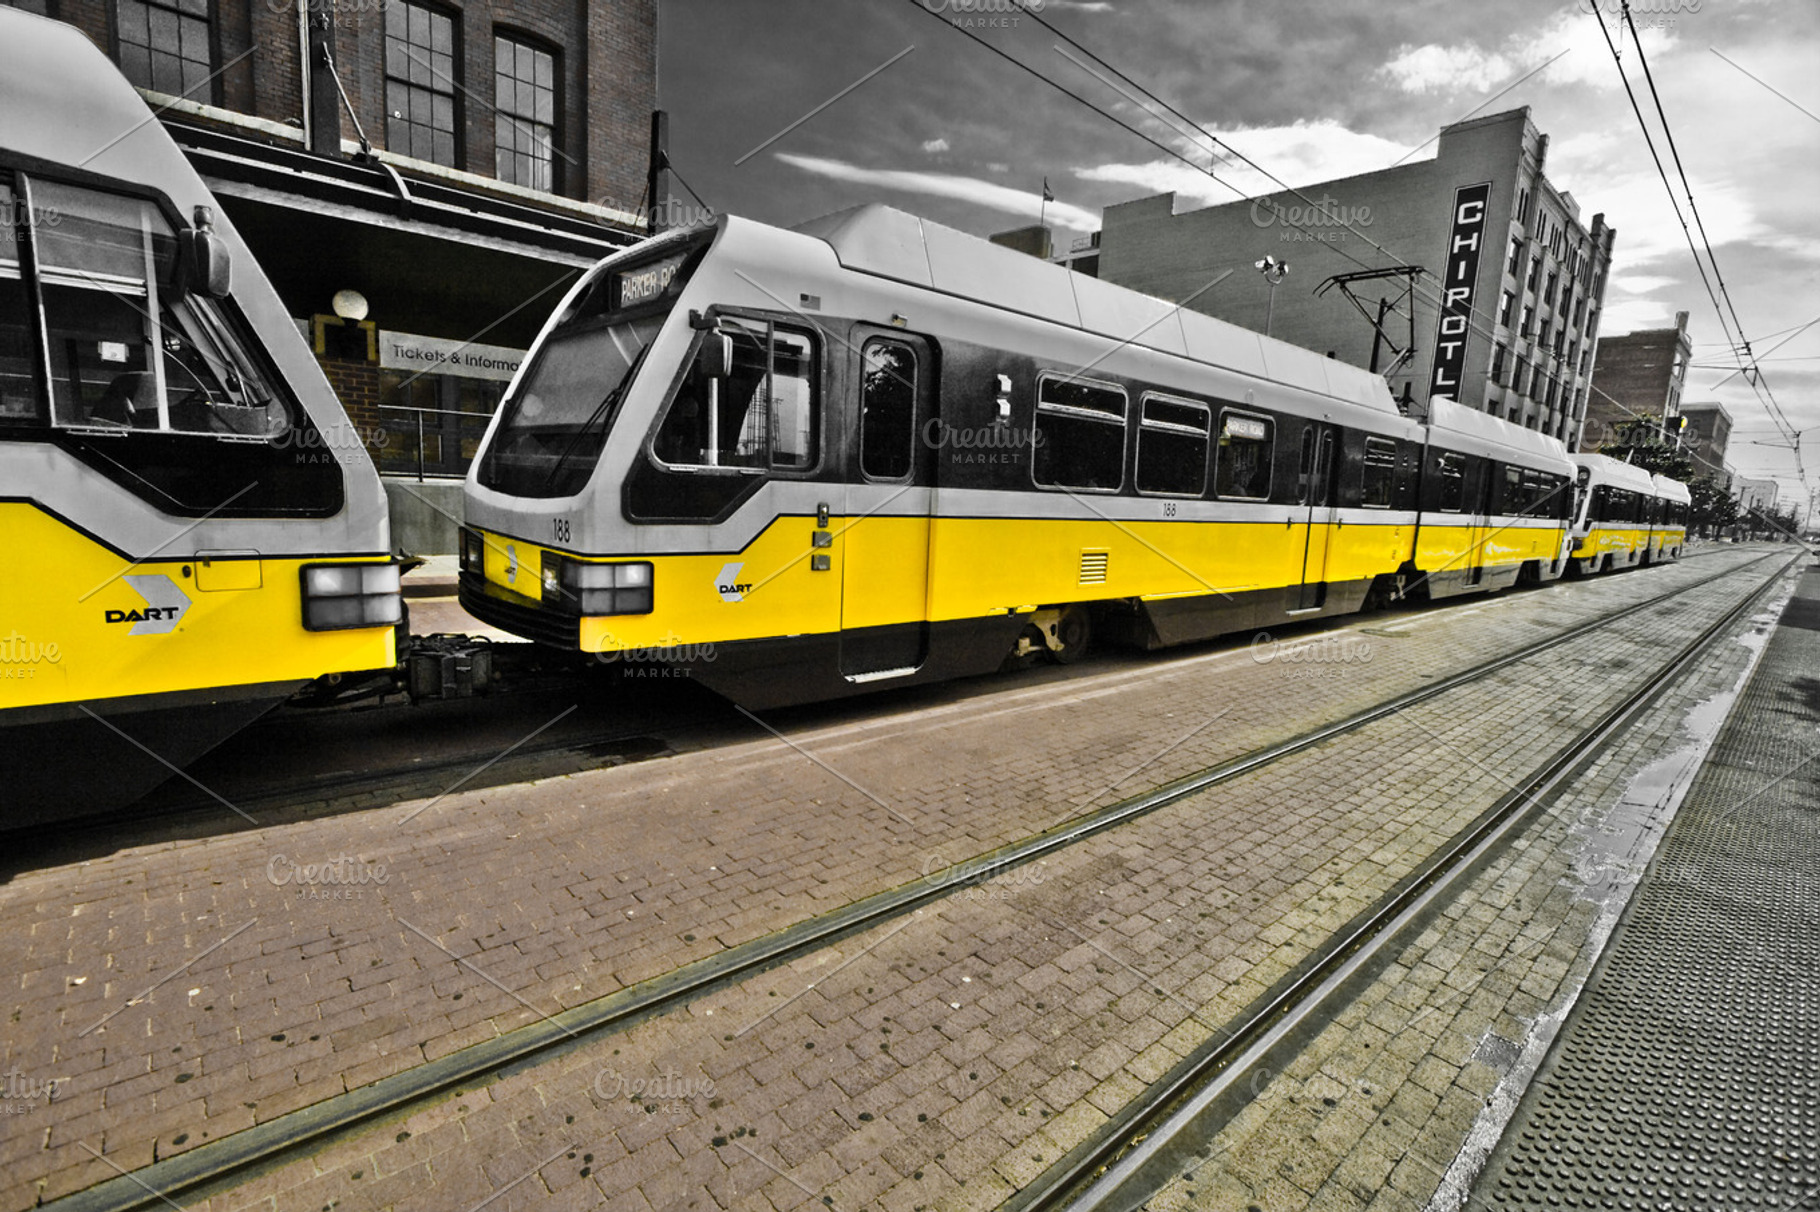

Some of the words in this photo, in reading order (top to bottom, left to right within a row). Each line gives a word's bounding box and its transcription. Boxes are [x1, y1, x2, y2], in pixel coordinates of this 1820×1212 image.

[621, 271, 656, 302] PARKER
[1432, 200, 1484, 398] CHIPOTL
[393, 344, 446, 363] Tickets
[451, 352, 461, 364] &
[465, 353, 522, 372] Informa
[1163, 503, 1176, 517] 188
[553, 518, 571, 543] 188
[719, 583, 752, 594] DART
[105, 606, 179, 624] DART
